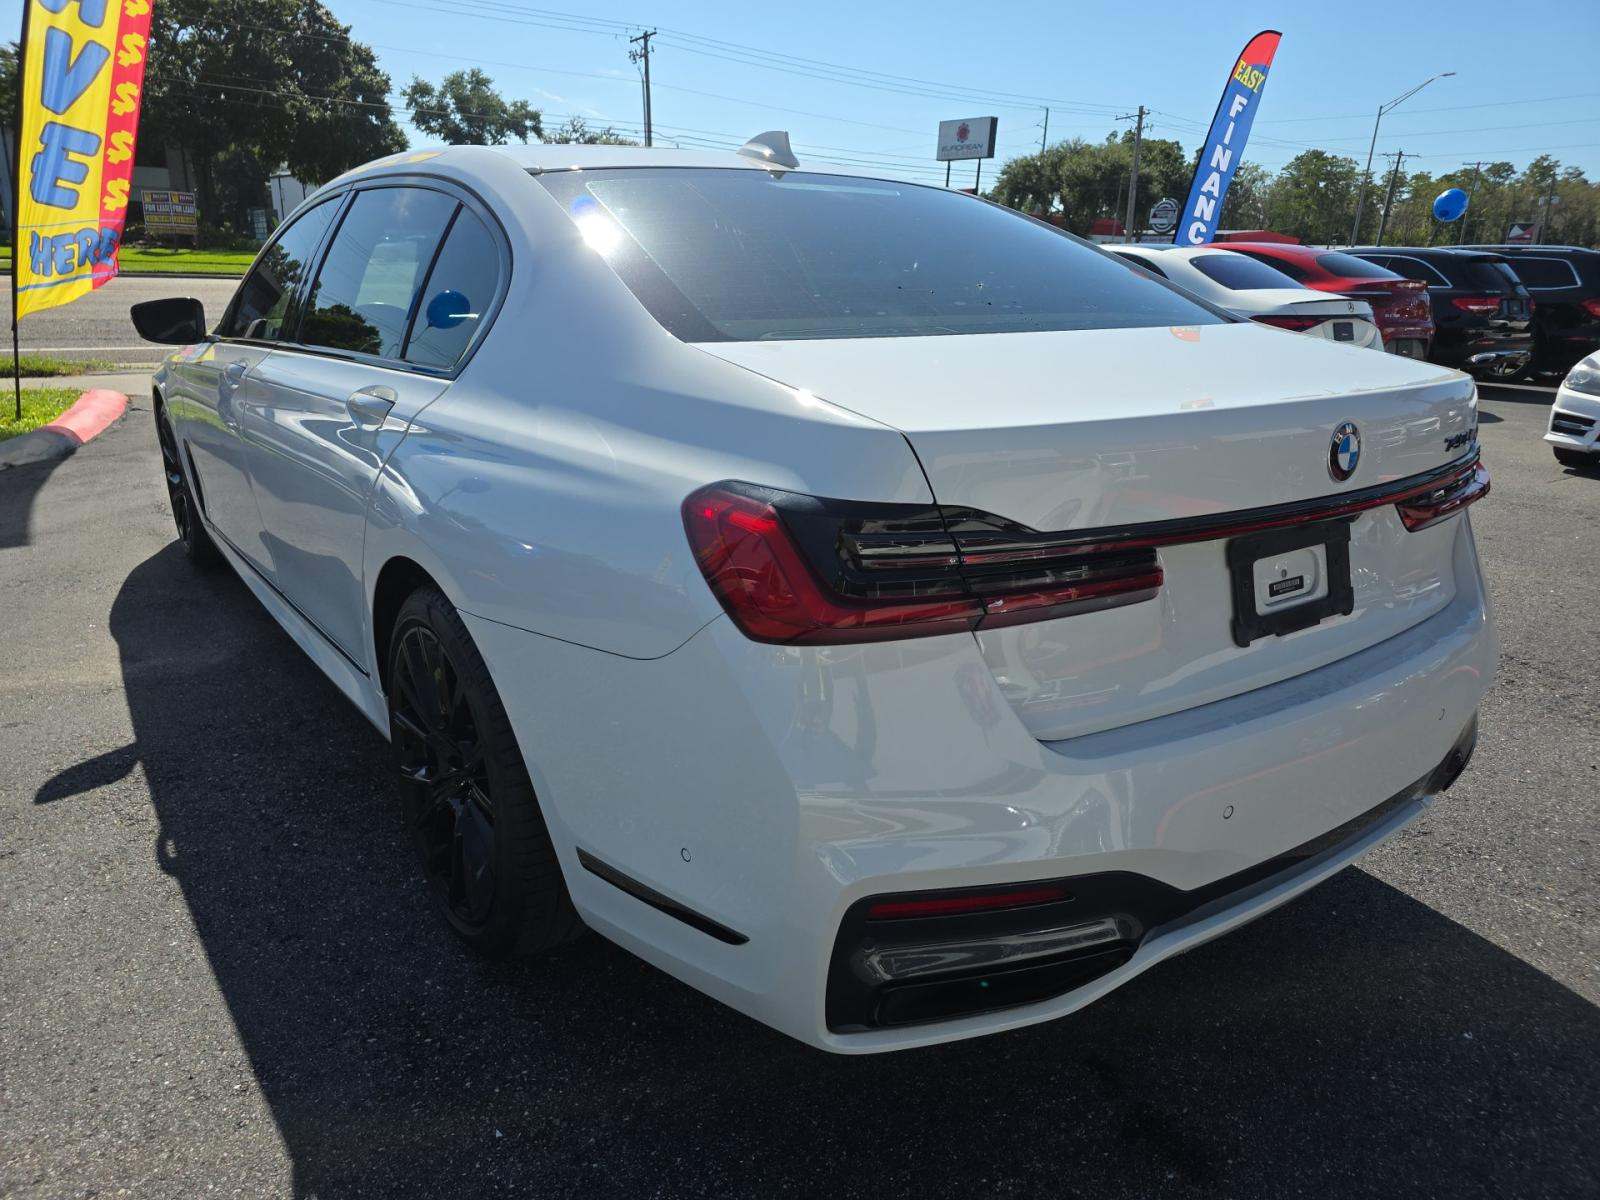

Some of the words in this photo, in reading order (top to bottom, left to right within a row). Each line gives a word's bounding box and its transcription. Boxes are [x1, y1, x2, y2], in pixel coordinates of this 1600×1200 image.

[30, 0, 110, 210] VE
[1233, 59, 1266, 94] EASY
[1188, 94, 1248, 245] FINANC
[30, 226, 119, 277] HERE
